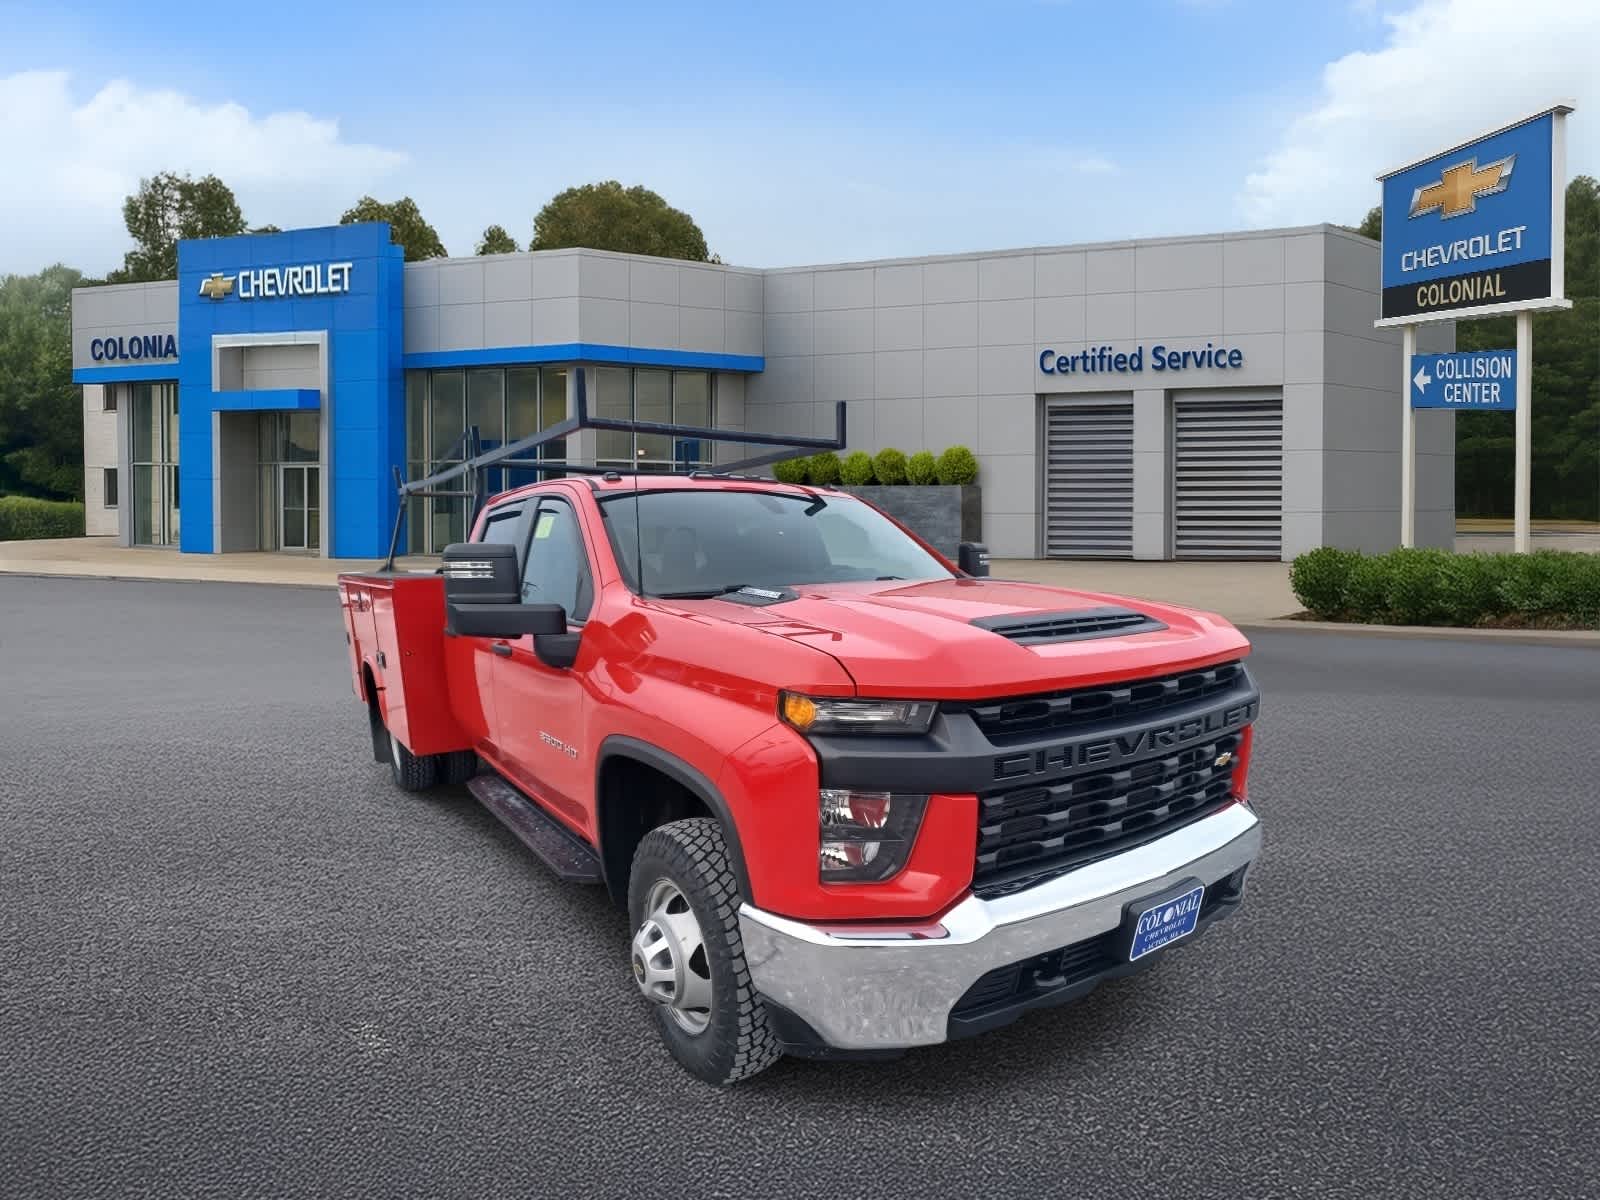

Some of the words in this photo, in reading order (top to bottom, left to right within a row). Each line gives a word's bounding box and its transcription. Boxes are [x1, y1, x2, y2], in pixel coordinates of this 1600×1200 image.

[1401, 225, 1527, 272] CHEVROLET
[239, 262, 353, 298] CHEVROLET
[1416, 274, 1507, 307] COLONIAL
[1039, 346, 1144, 375] Certified
[1151, 343, 1244, 371] Service
[1435, 356, 1512, 379] COLLISION
[1444, 382, 1501, 404] CENTER
[993, 703, 1257, 781] CHEVROLET
[1138, 894, 1199, 935] COLONIAL
